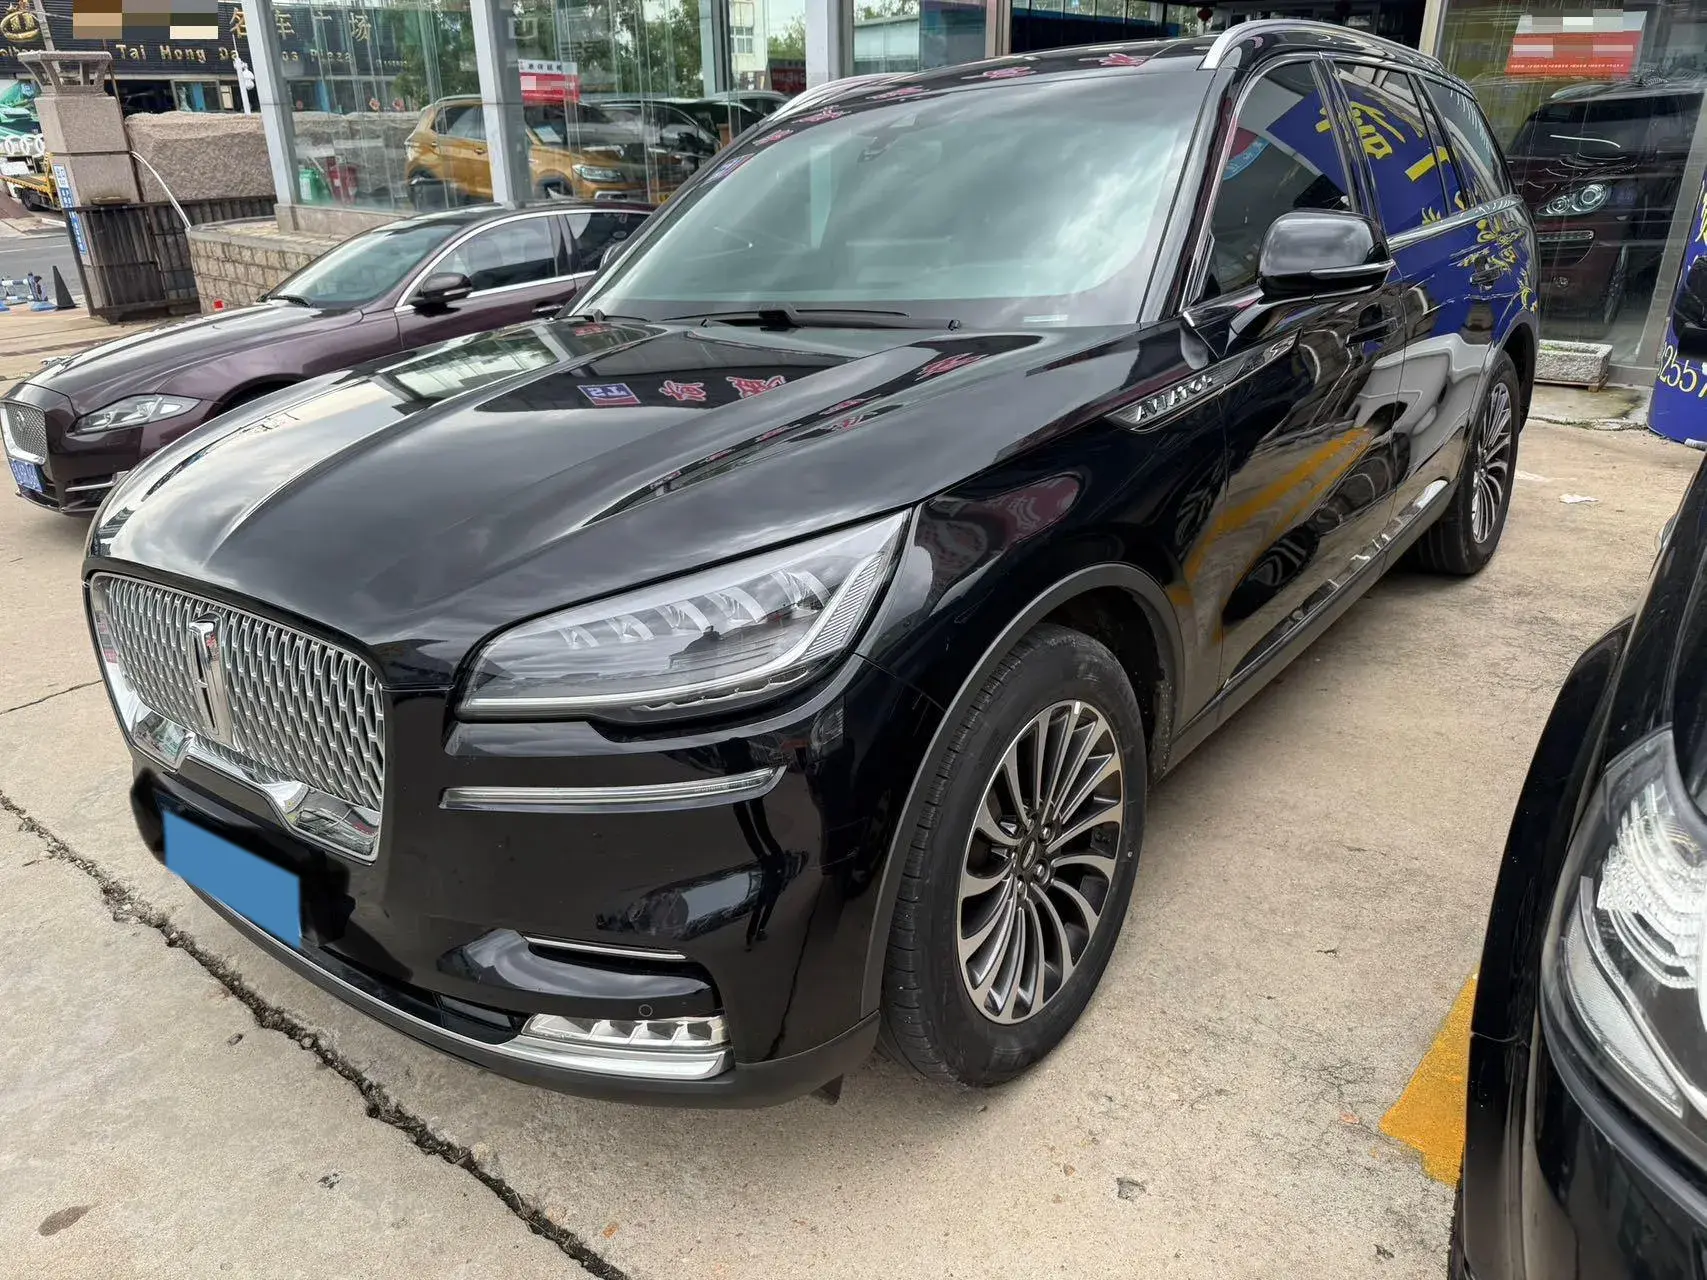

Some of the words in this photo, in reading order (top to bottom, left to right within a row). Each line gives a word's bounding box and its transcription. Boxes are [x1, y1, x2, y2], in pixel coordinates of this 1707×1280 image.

[115, 44, 147, 60] Tai
[159, 44, 207, 64] Hong
[1135, 374, 1214, 422] AVIATOR
